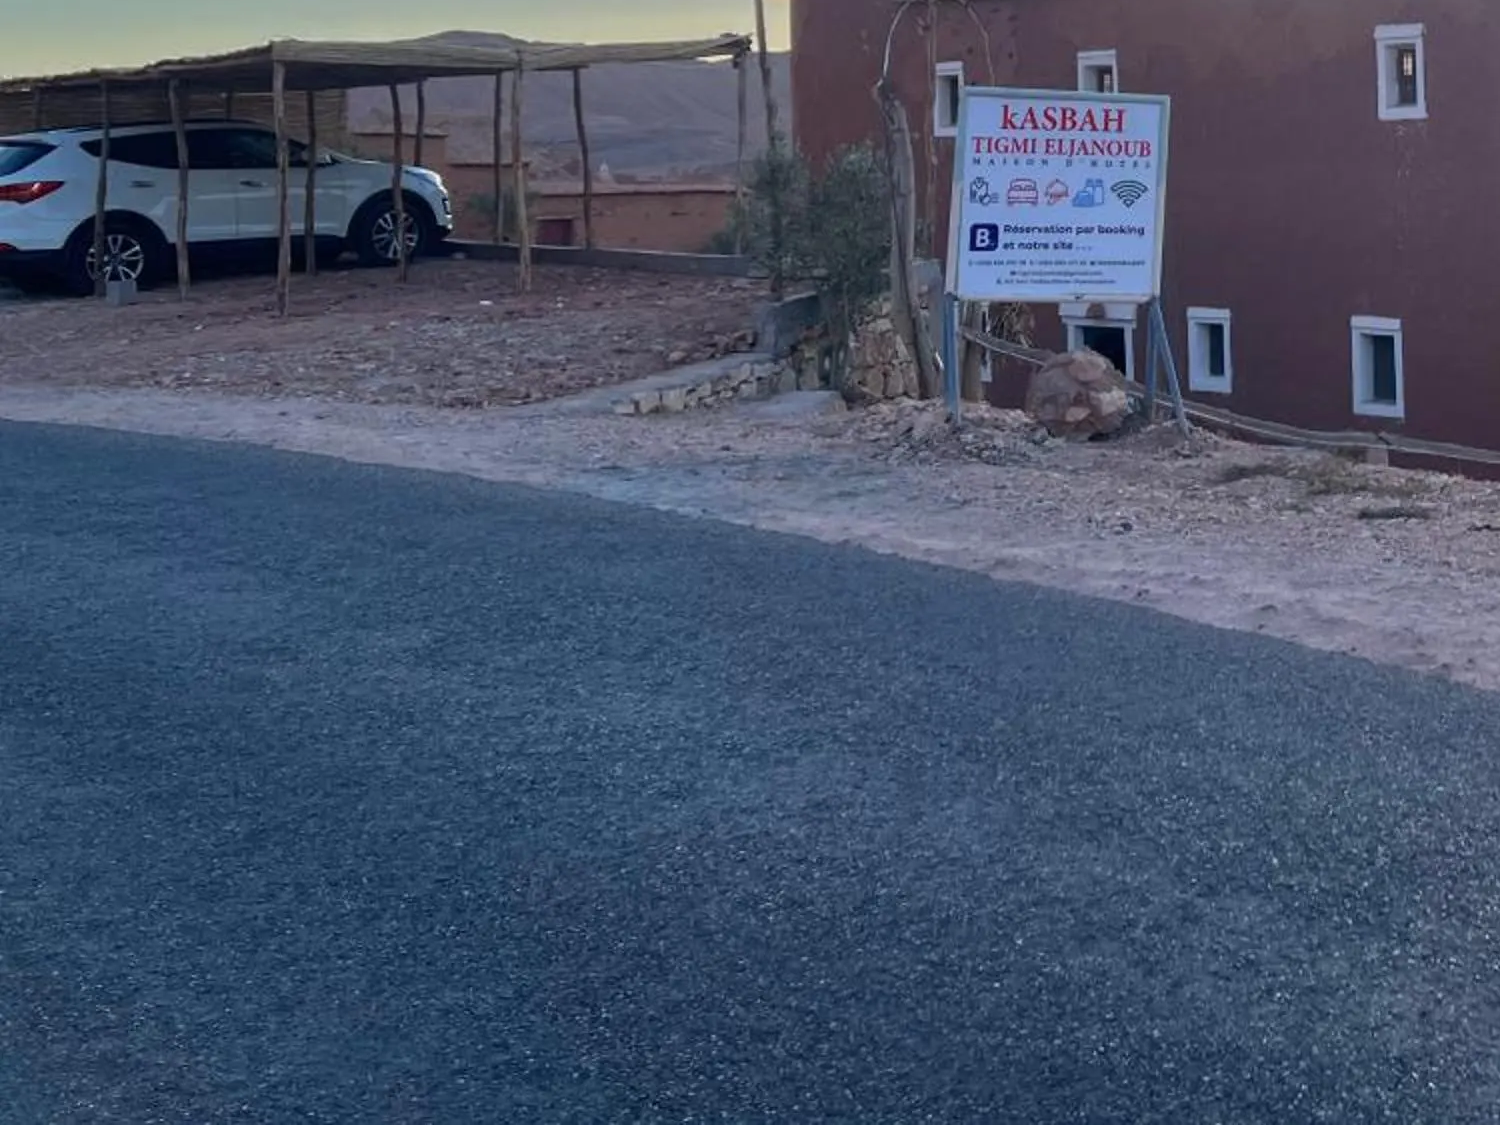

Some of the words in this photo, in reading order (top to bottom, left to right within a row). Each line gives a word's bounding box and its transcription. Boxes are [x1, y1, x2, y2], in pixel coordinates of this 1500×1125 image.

[1000, 105, 1126, 133] kASBAH
[971, 136, 1038, 155] TIGMI
[1044, 138, 1152, 158] ELJANOUB
[1003, 225, 1073, 235] Réservation
[1076, 227, 1095, 236] par
[1098, 225, 1145, 236] booking
[1002, 241, 1014, 250] et
[1017, 241, 1049, 251] notre
[1053, 241, 1073, 251] site
